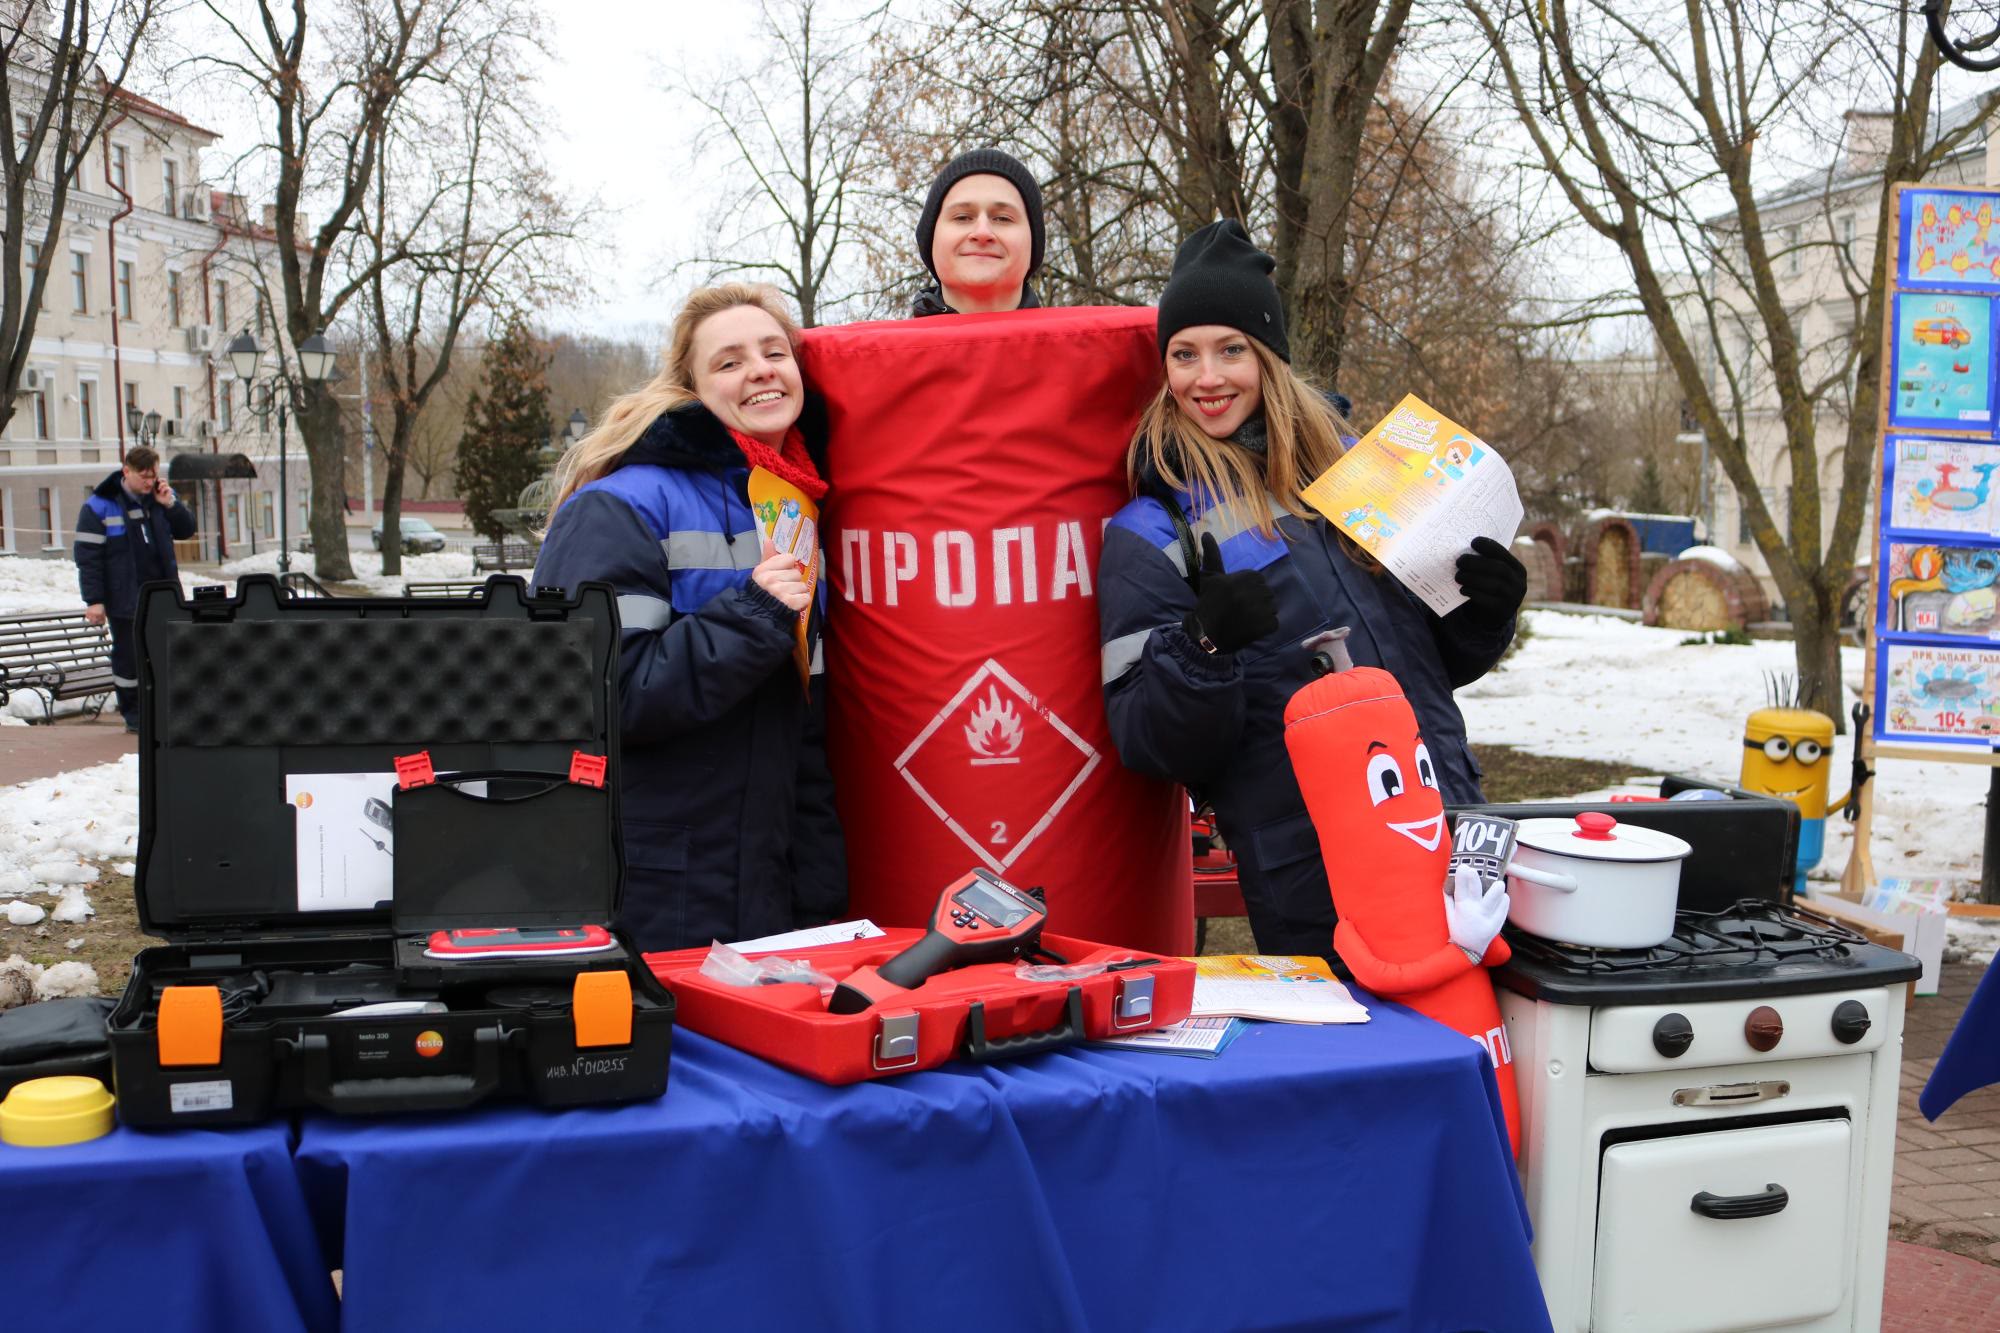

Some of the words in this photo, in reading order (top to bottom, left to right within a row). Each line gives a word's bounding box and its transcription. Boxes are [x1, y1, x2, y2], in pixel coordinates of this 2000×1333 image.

[842, 517, 1112, 607] ПРОПА
[1935, 711, 1966, 728] 104
[990, 821, 1007, 843] 2
[1455, 820, 1509, 857] 104
[417, 1040, 443, 1048] testo
